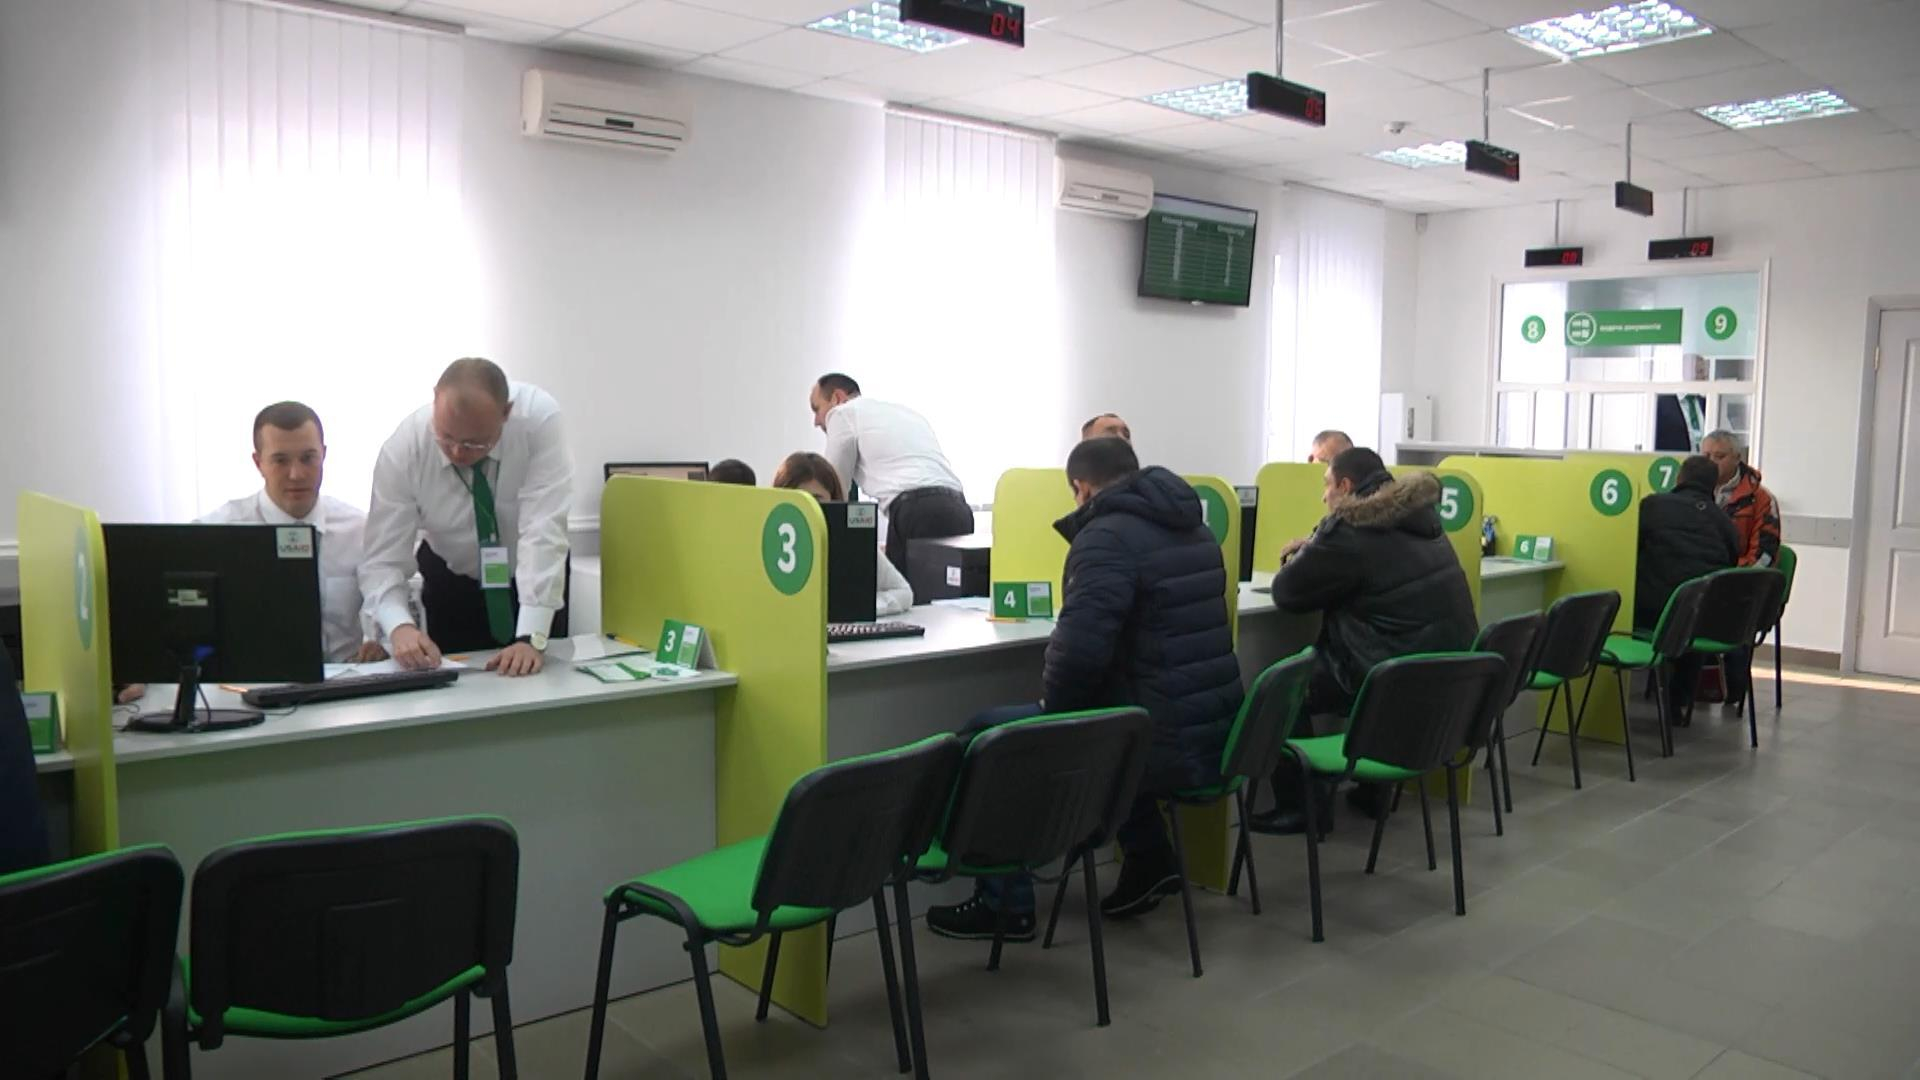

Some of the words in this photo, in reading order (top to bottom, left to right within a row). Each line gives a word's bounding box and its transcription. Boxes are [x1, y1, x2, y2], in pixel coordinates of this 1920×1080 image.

[991, 12, 1019, 39] 04
[1527, 320, 1539, 339] 8
[1715, 313, 1727, 334] 9
[1659, 465, 1673, 489] 7
[1440, 486, 1458, 520] 5
[1601, 478, 1619, 506] 6
[777, 522, 796, 574] 3
[1520, 539, 1529, 554] 6
[1003, 590, 1016, 608] 4
[664, 629, 676, 652] 3
